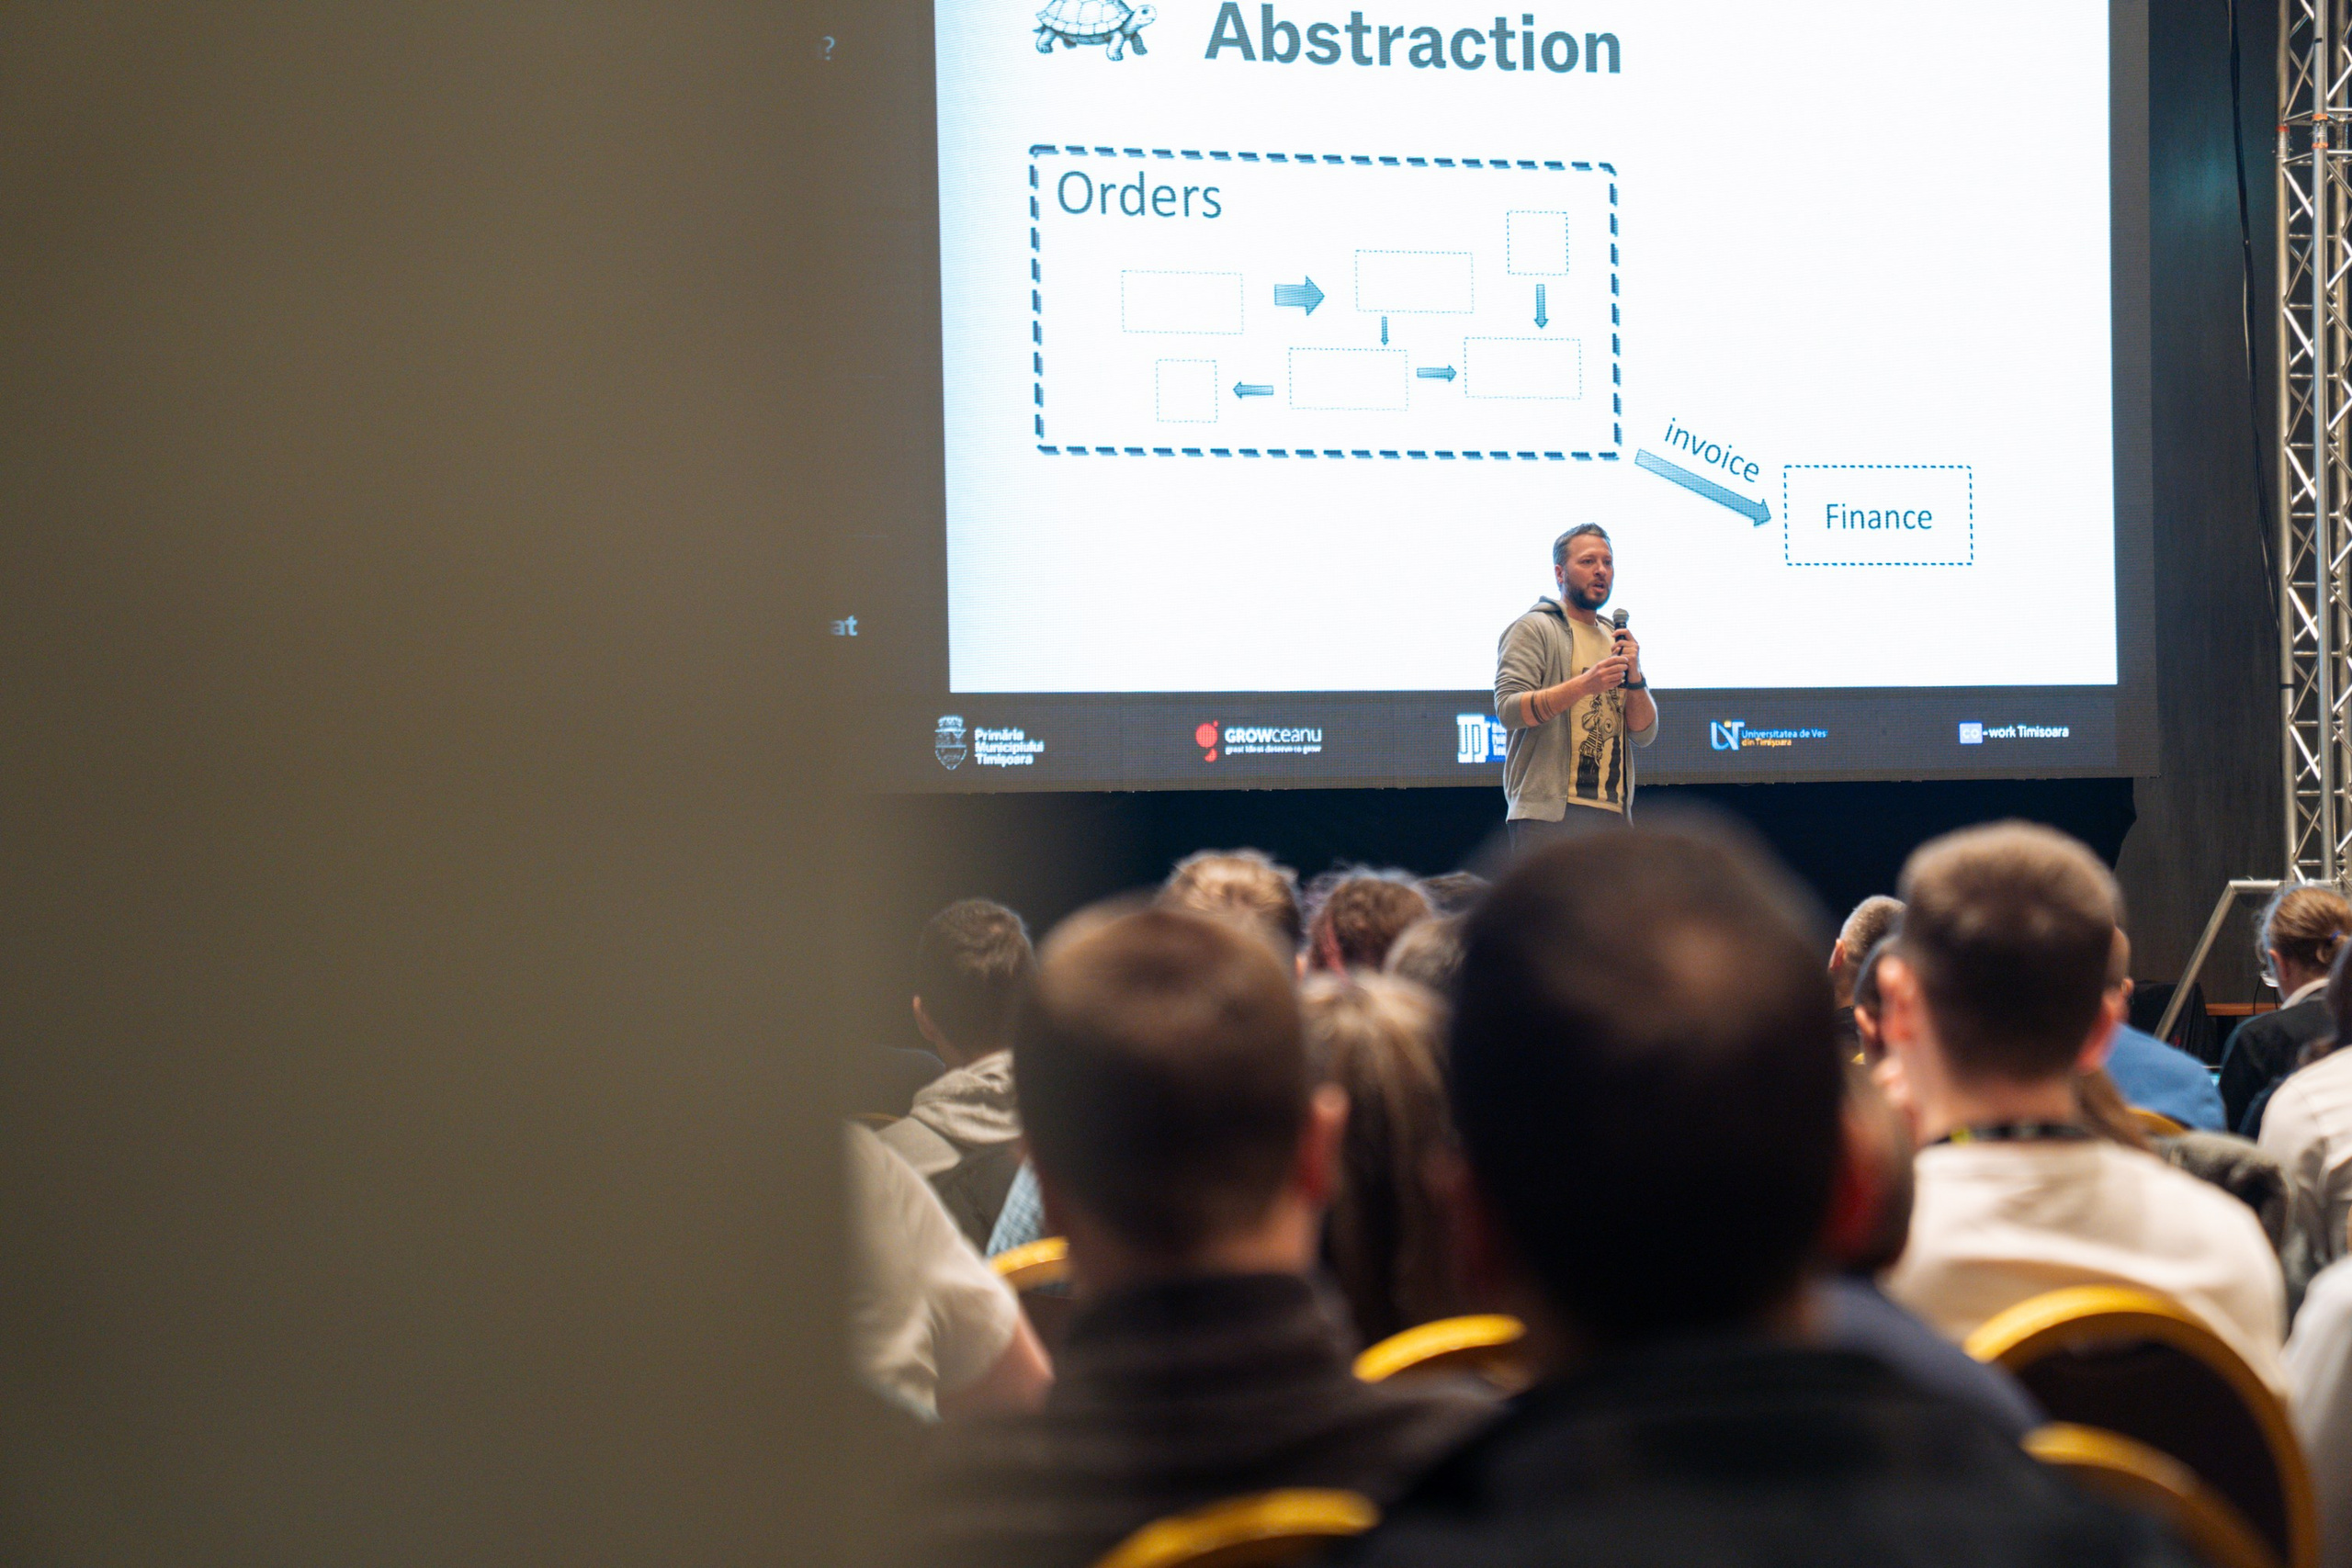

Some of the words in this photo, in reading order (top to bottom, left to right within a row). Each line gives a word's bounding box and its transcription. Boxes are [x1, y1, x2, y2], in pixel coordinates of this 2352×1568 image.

[1204, 1, 1622, 74] Abstraction
[1057, 170, 1222, 219] Orders
[1664, 417, 1760, 483] invoice
[1826, 502, 1933, 530] Finance
[1224, 727, 1322, 743] GROWceanu
[1741, 729, 1798, 739] Universitatea
[1799, 728, 1811, 739] de
[1811, 728, 1828, 739] Ves
[2017, 724, 2070, 738] Timisoara
[974, 739, 1046, 755] Municipiului
[1741, 739, 1755, 747] din
